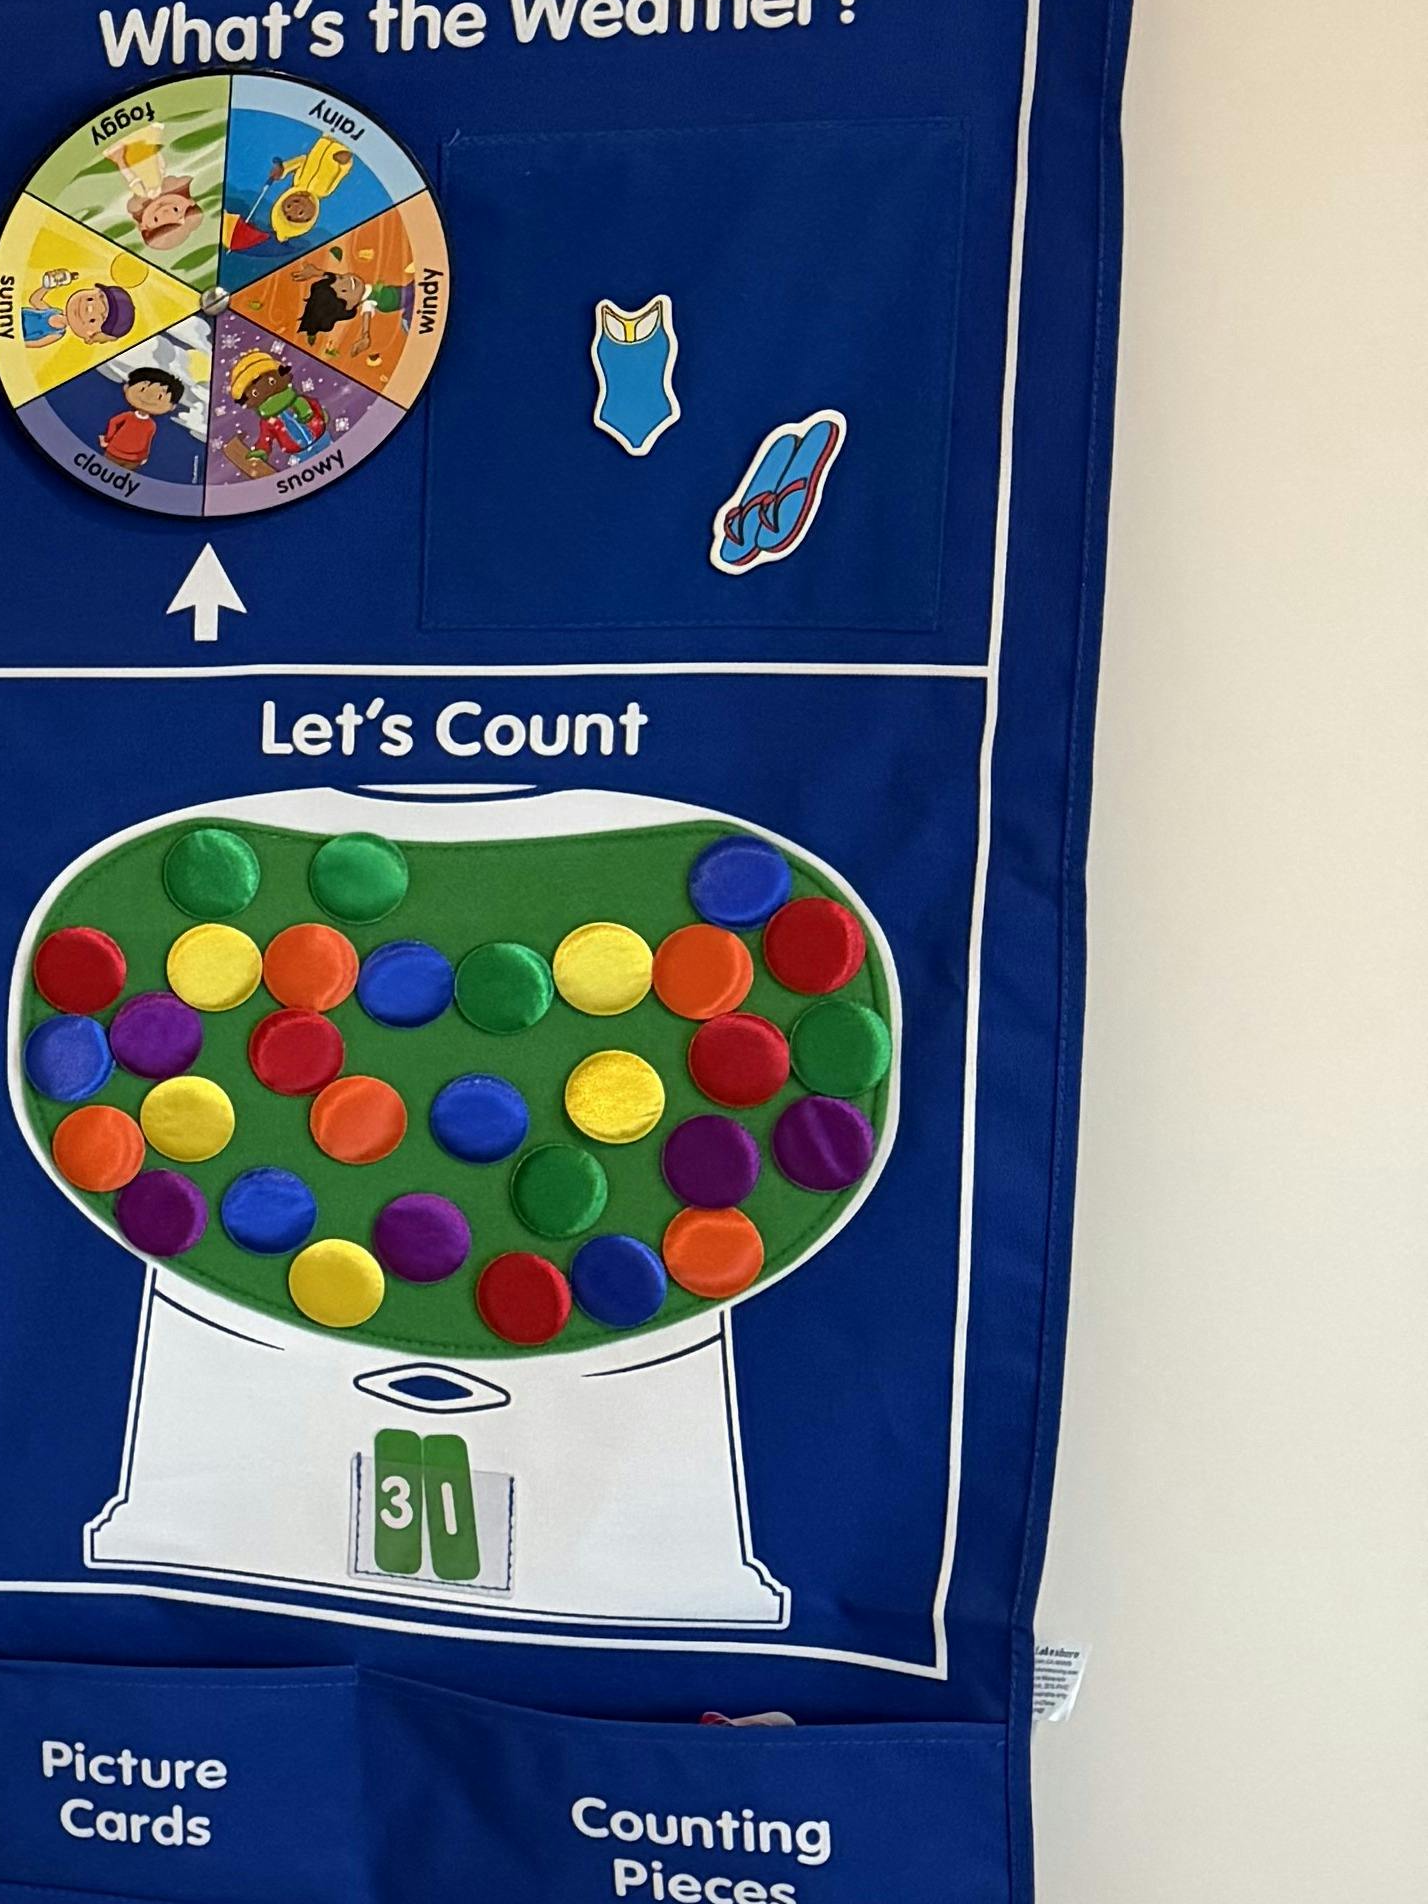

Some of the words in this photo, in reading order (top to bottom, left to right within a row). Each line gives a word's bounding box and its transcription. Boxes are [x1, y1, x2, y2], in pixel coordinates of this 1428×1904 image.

[91, 101, 156, 146] foggy
[309, 99, 366, 143] rainy
[416, 266, 444, 335] windy
[72, 451, 141, 496] cloudy
[276, 448, 345, 495] snowy
[262, 698, 413, 756] Let's
[436, 702, 648, 756] Count
[43, 1741, 227, 1789] Picture
[61, 1799, 210, 1845] Cards
[571, 1796, 831, 1866] Counting
